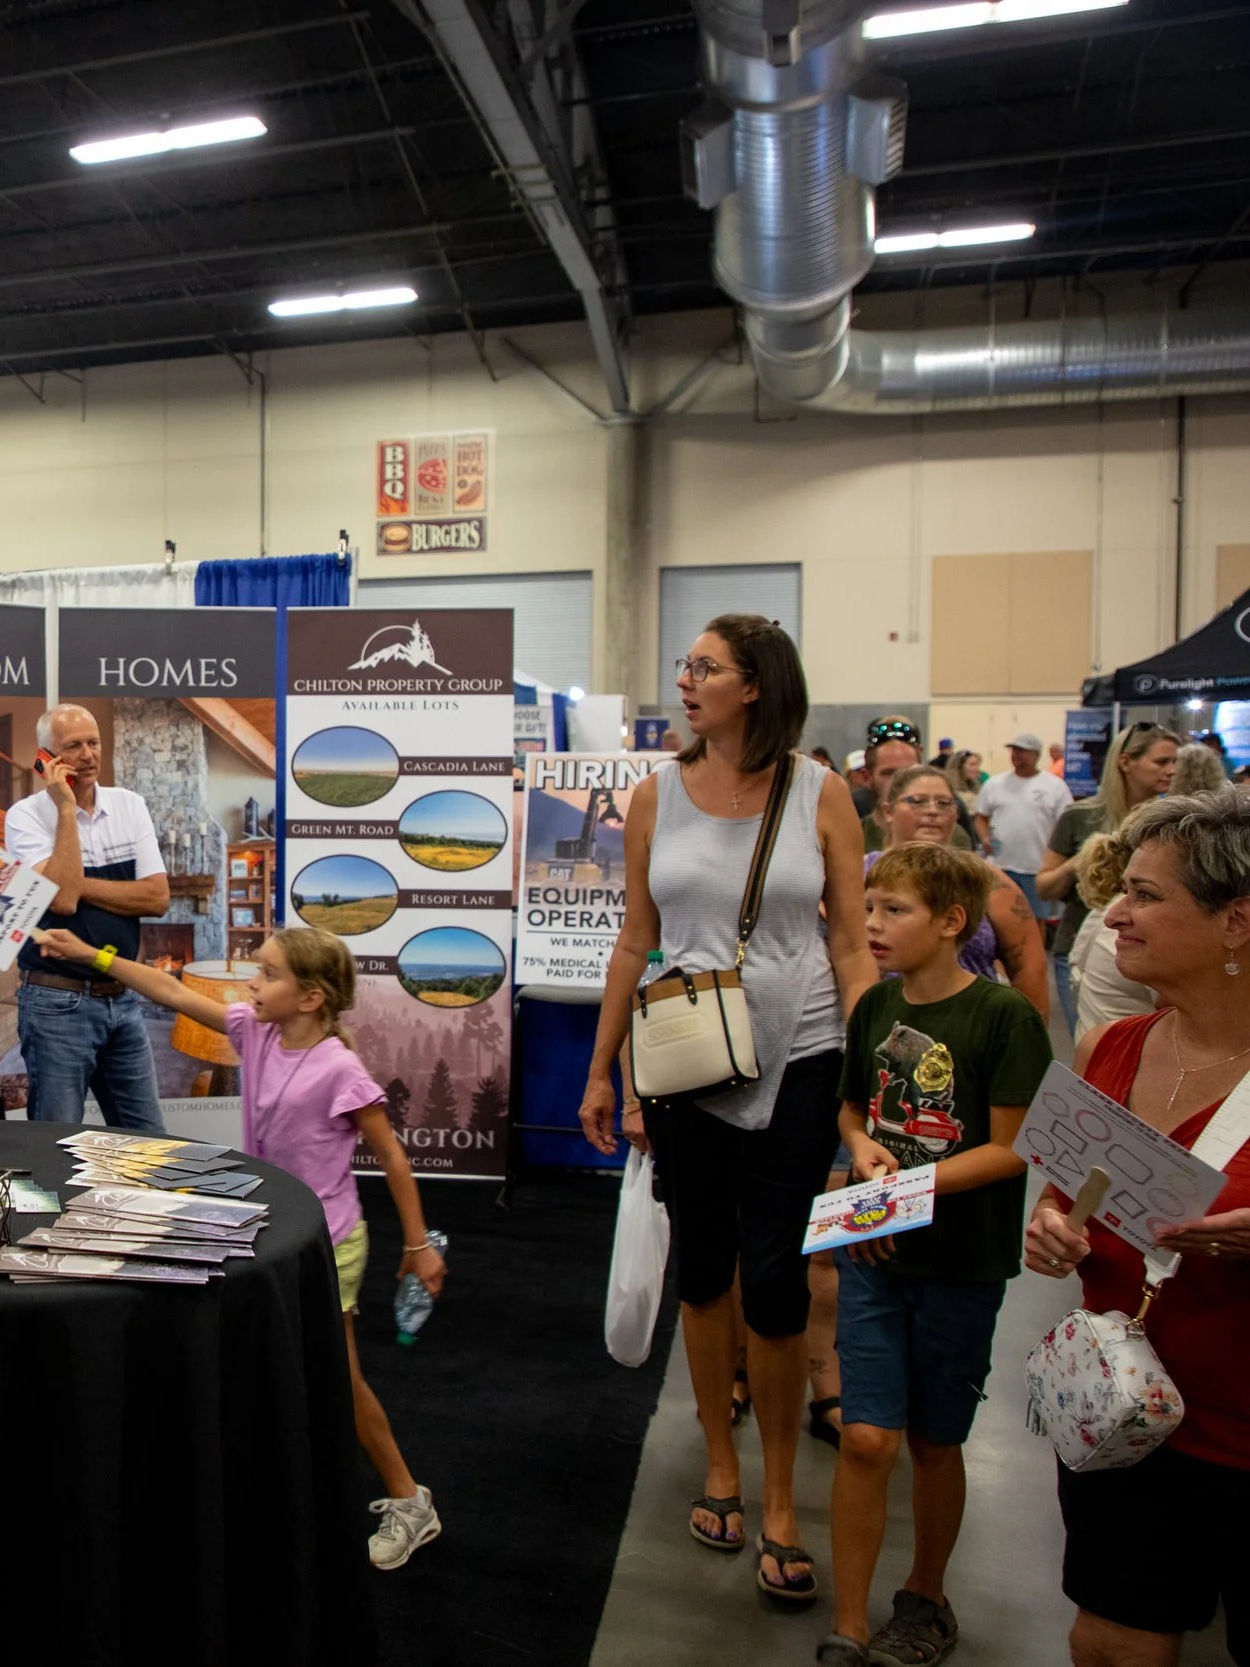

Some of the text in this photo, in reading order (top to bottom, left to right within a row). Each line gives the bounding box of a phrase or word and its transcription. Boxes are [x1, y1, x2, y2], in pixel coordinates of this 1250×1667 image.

[457, 450, 482, 462] HOT
[383, 445, 405, 500] BBQ
[411, 520, 480, 551] BURGERS
[98, 656, 239, 689] HOMES
[293, 678, 503, 692] CHILTON PROPERTY GROUP
[1159, 678, 1215, 690] Purelight
[341, 700, 460, 711] AVAILABLE LOTS
[403, 761, 506, 772] CASCADIA LANE
[291, 824, 394, 835] GREEN MT. ROAD
[549, 868, 572, 880] CAT
[411, 893, 495, 906] RESORT LANE
[550, 937, 615, 948] WE MATCH
[369, 959, 390, 971] DR.
[522, 957, 602, 969] 75% MEDICAL
[546, 968, 602, 979] PAID FOR
